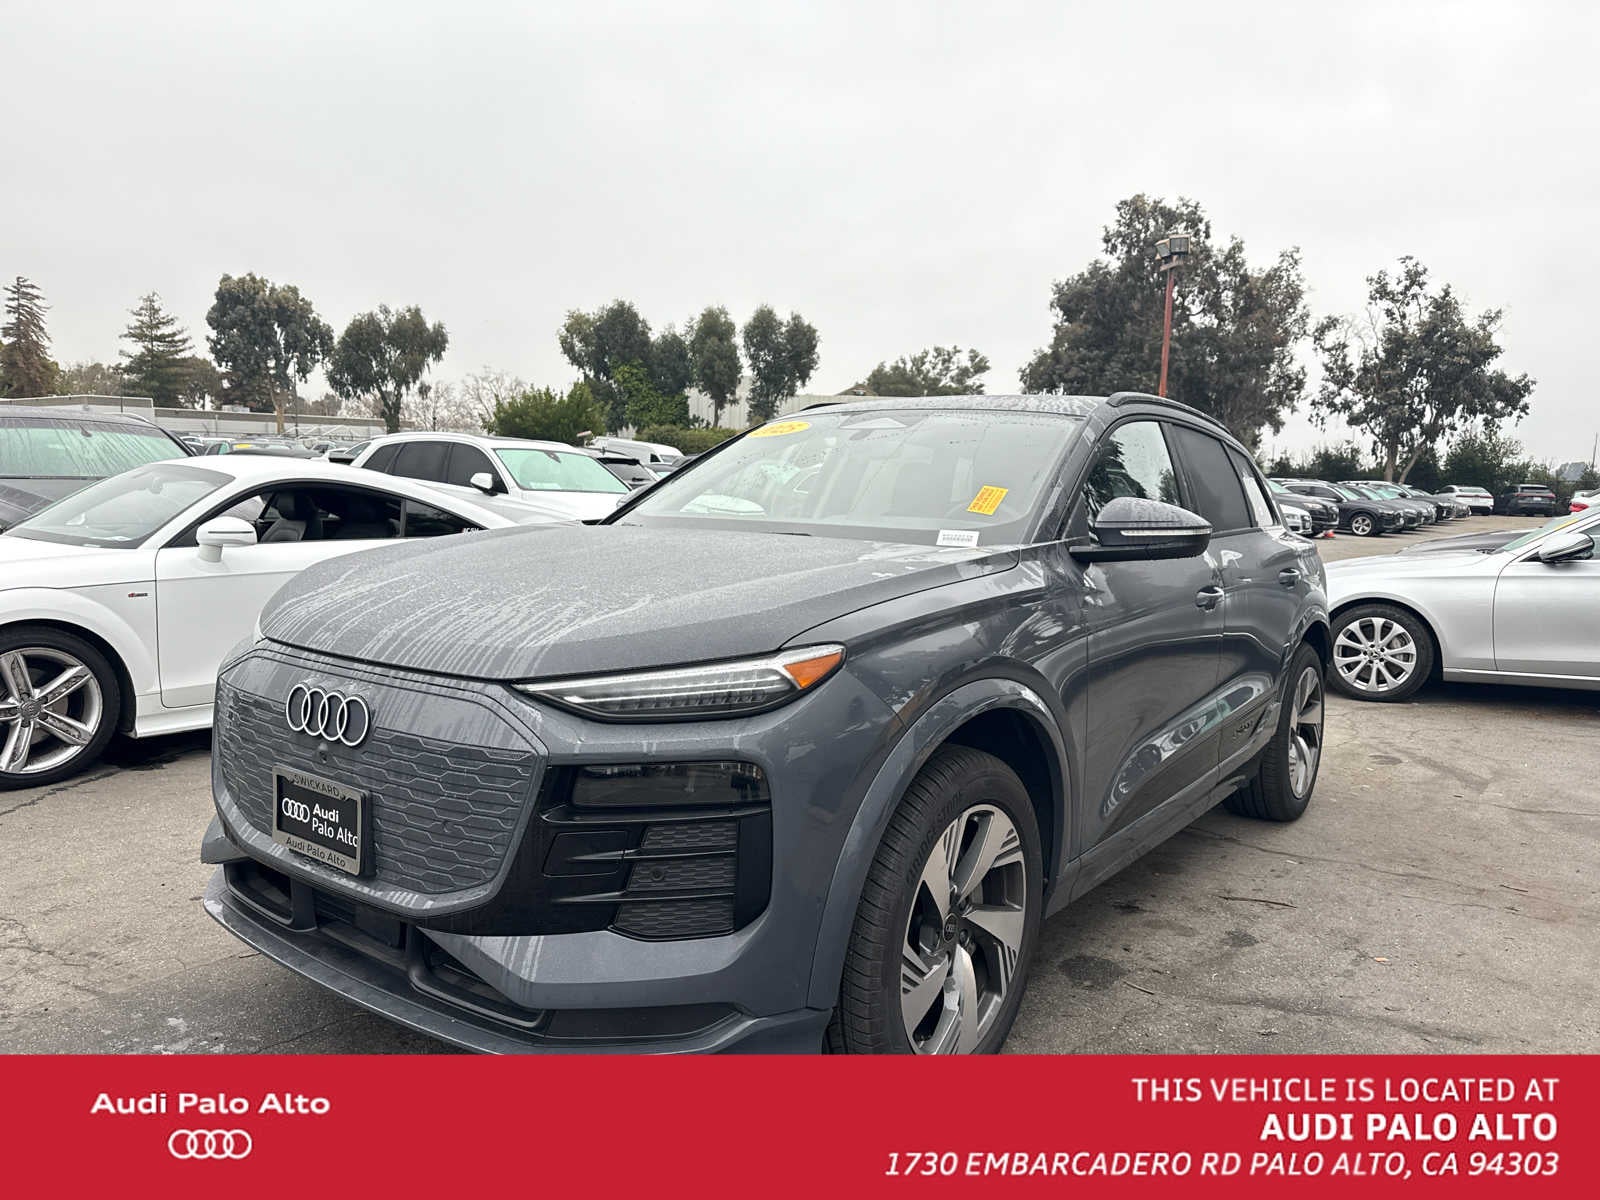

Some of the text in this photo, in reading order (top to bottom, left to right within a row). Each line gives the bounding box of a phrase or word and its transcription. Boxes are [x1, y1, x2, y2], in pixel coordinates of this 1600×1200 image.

[294, 774, 340, 797] SWICKARD
[312, 803, 339, 824] Audi
[312, 817, 334, 838] Palo
[286, 837, 346, 867] Audi Palo Alto
